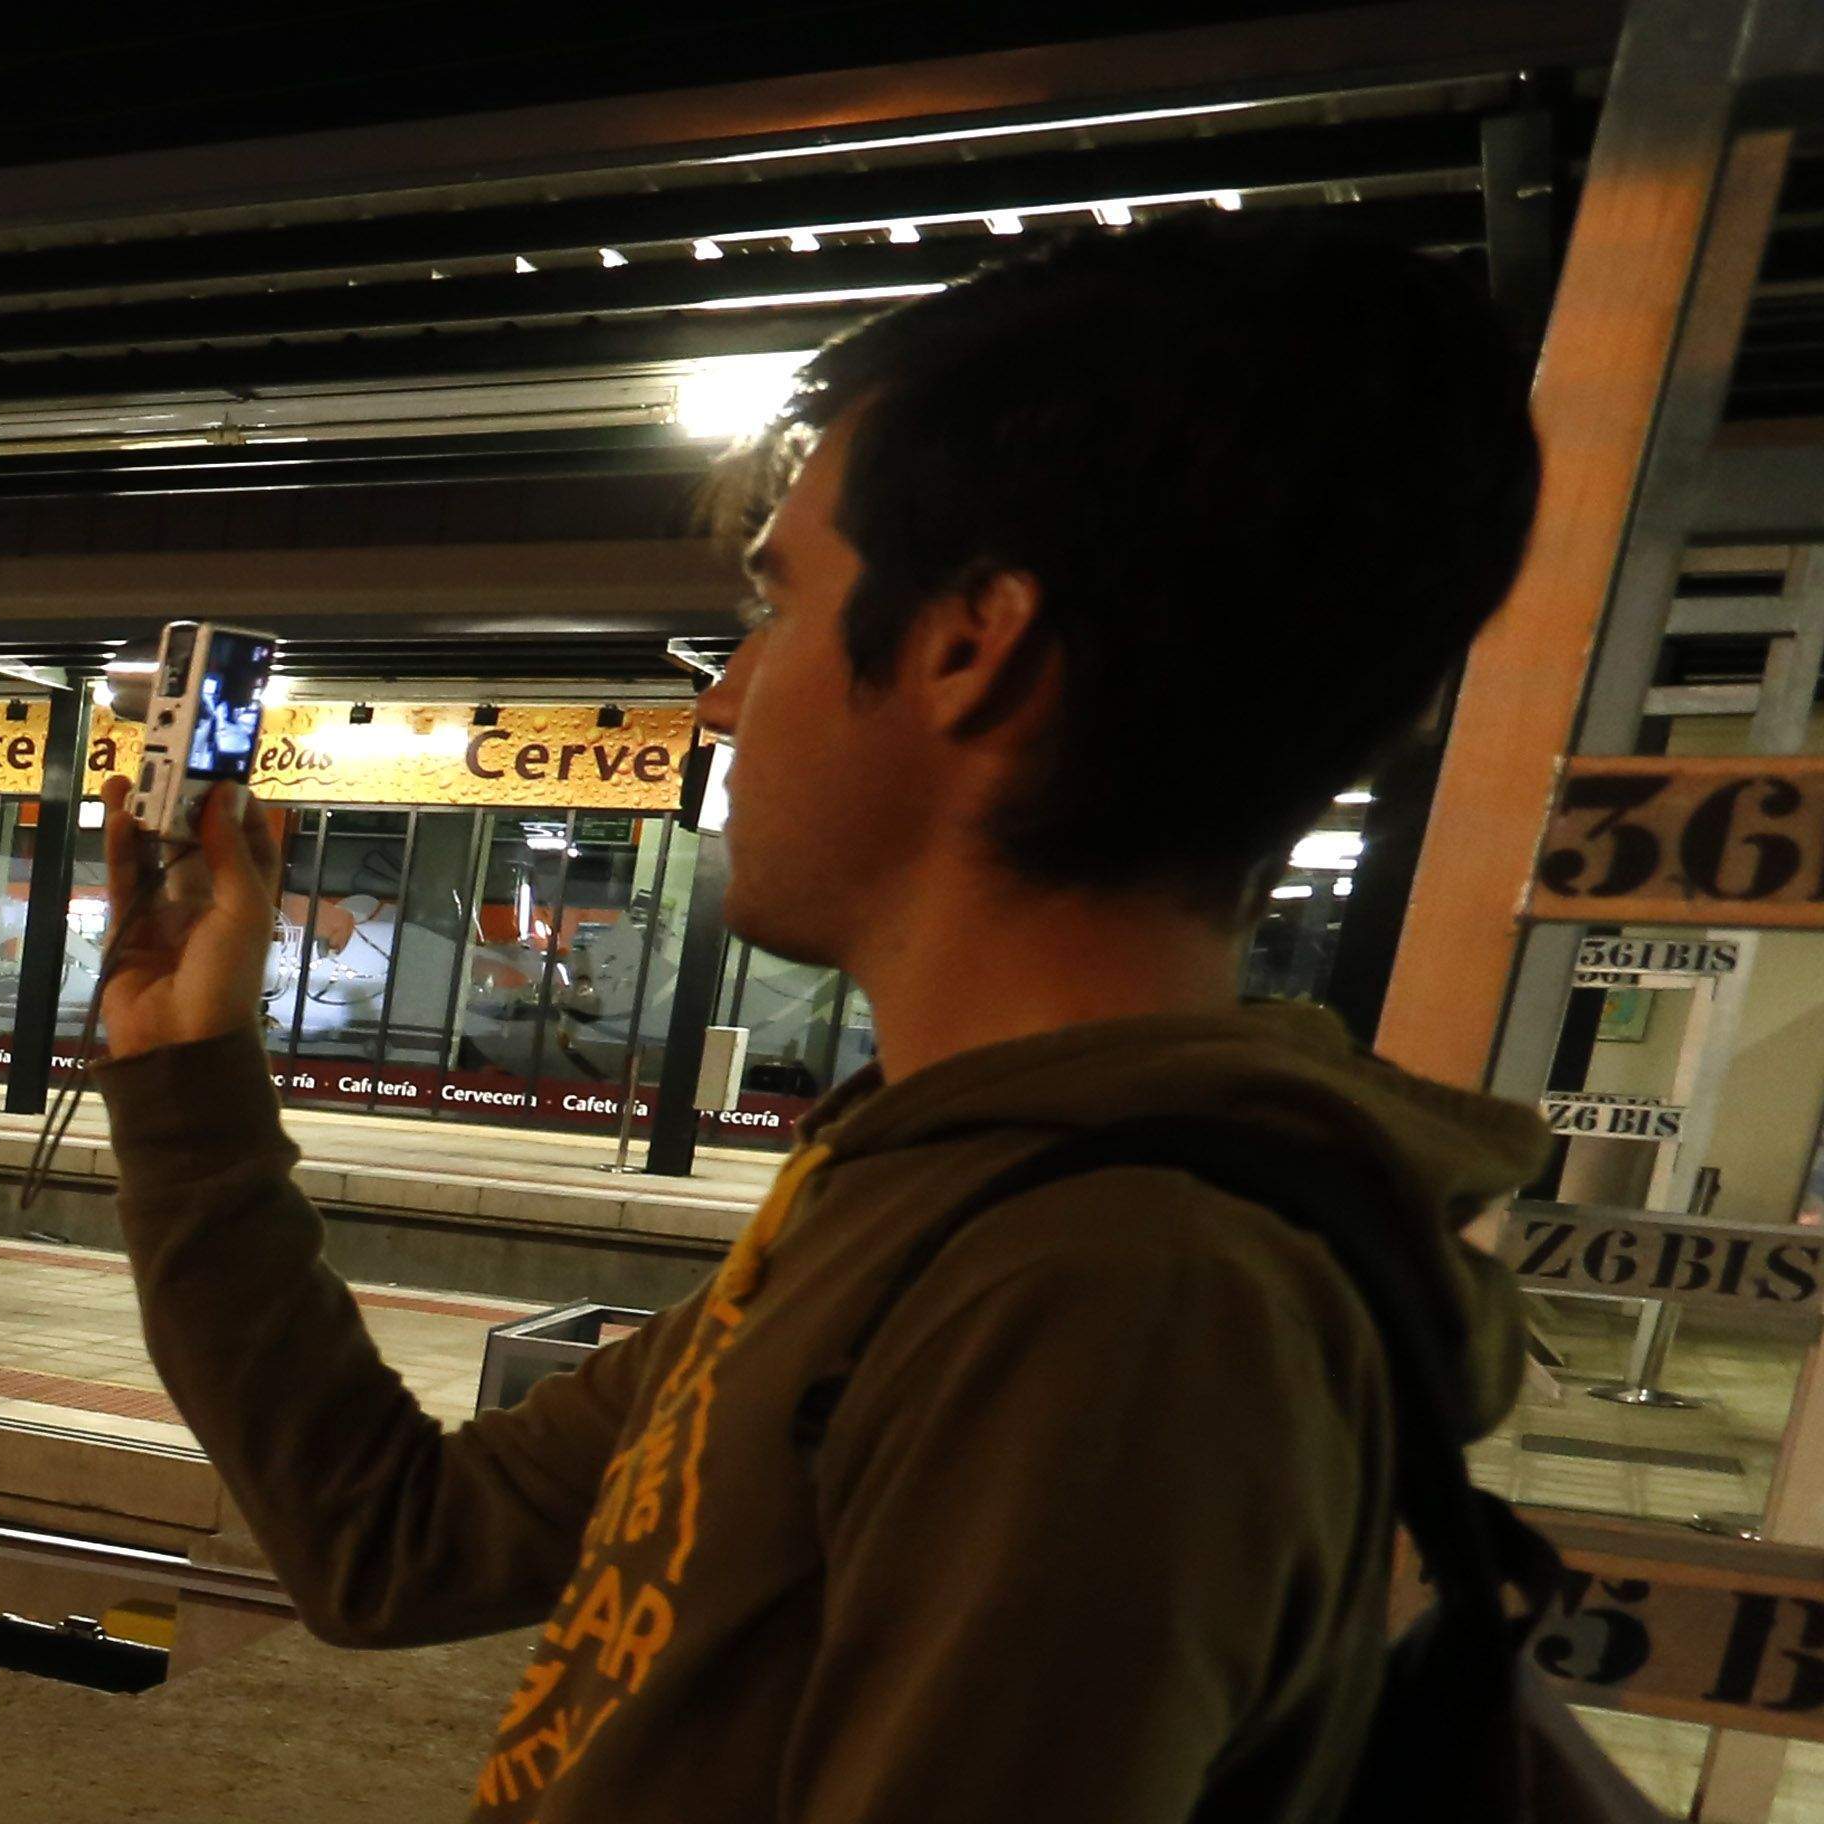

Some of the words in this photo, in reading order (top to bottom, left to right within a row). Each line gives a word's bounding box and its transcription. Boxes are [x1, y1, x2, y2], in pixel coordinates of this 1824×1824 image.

[466, 728, 688, 782] Cerve
[1539, 774, 1824, 902] 36
[1608, 1107, 1681, 1137] BIS
[1648, 1231, 1822, 1302] BIS
